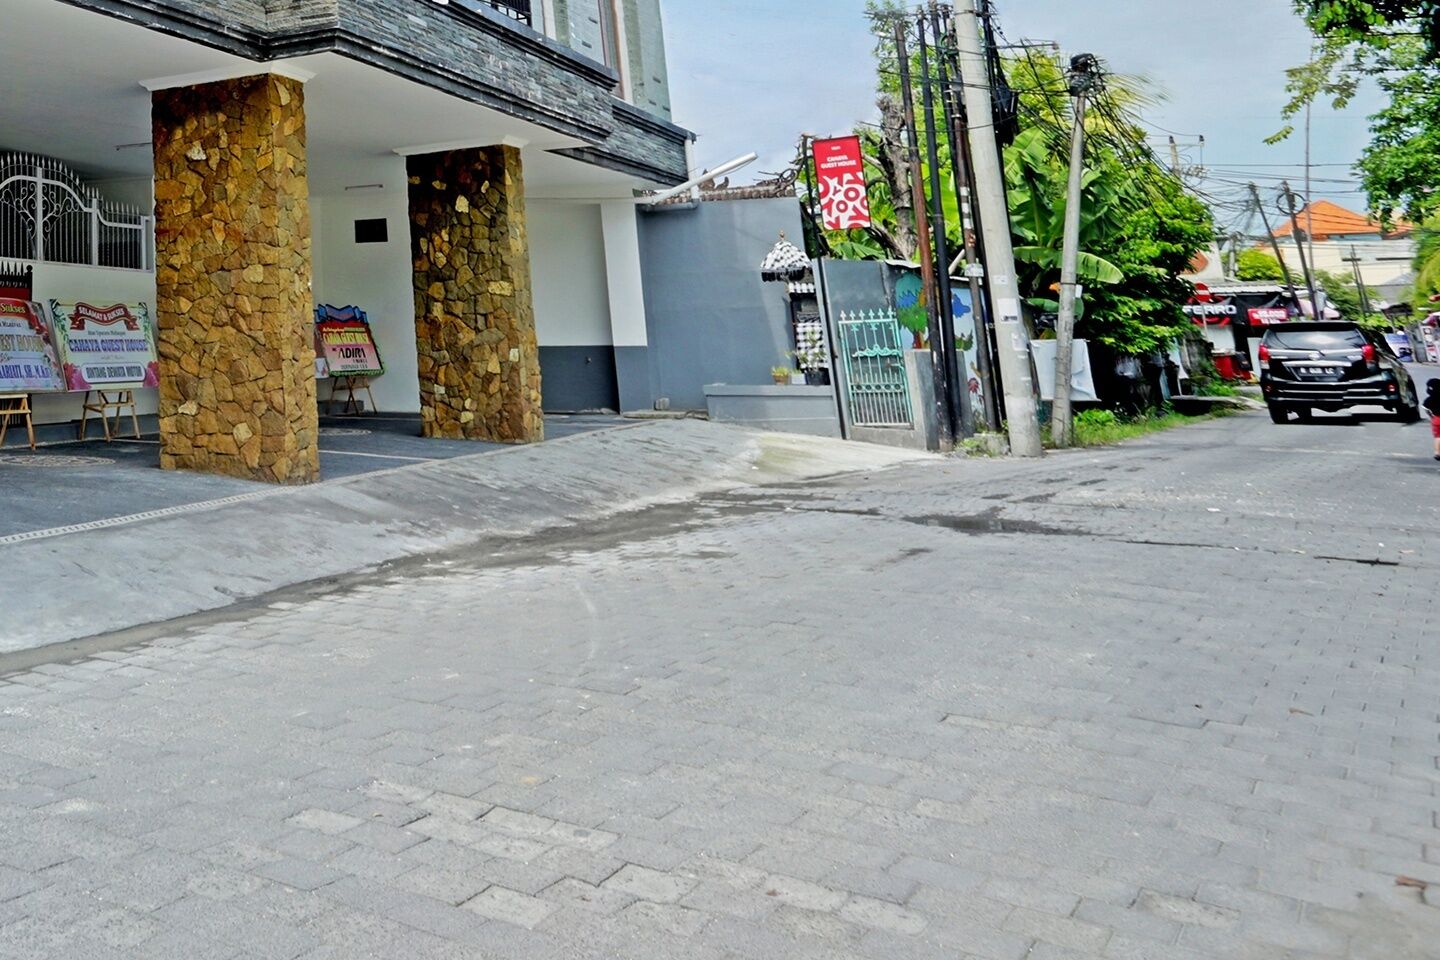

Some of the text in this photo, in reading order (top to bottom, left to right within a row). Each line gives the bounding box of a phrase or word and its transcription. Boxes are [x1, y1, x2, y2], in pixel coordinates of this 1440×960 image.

[0, 302, 26, 313] Sukses
[1182, 305, 1237, 315] FERRO
[79, 307, 102, 320] SELAMAT
[69, 339, 148, 352] CAHAYA GUEST HOUSE
[339, 347, 366, 358] ADIRA
